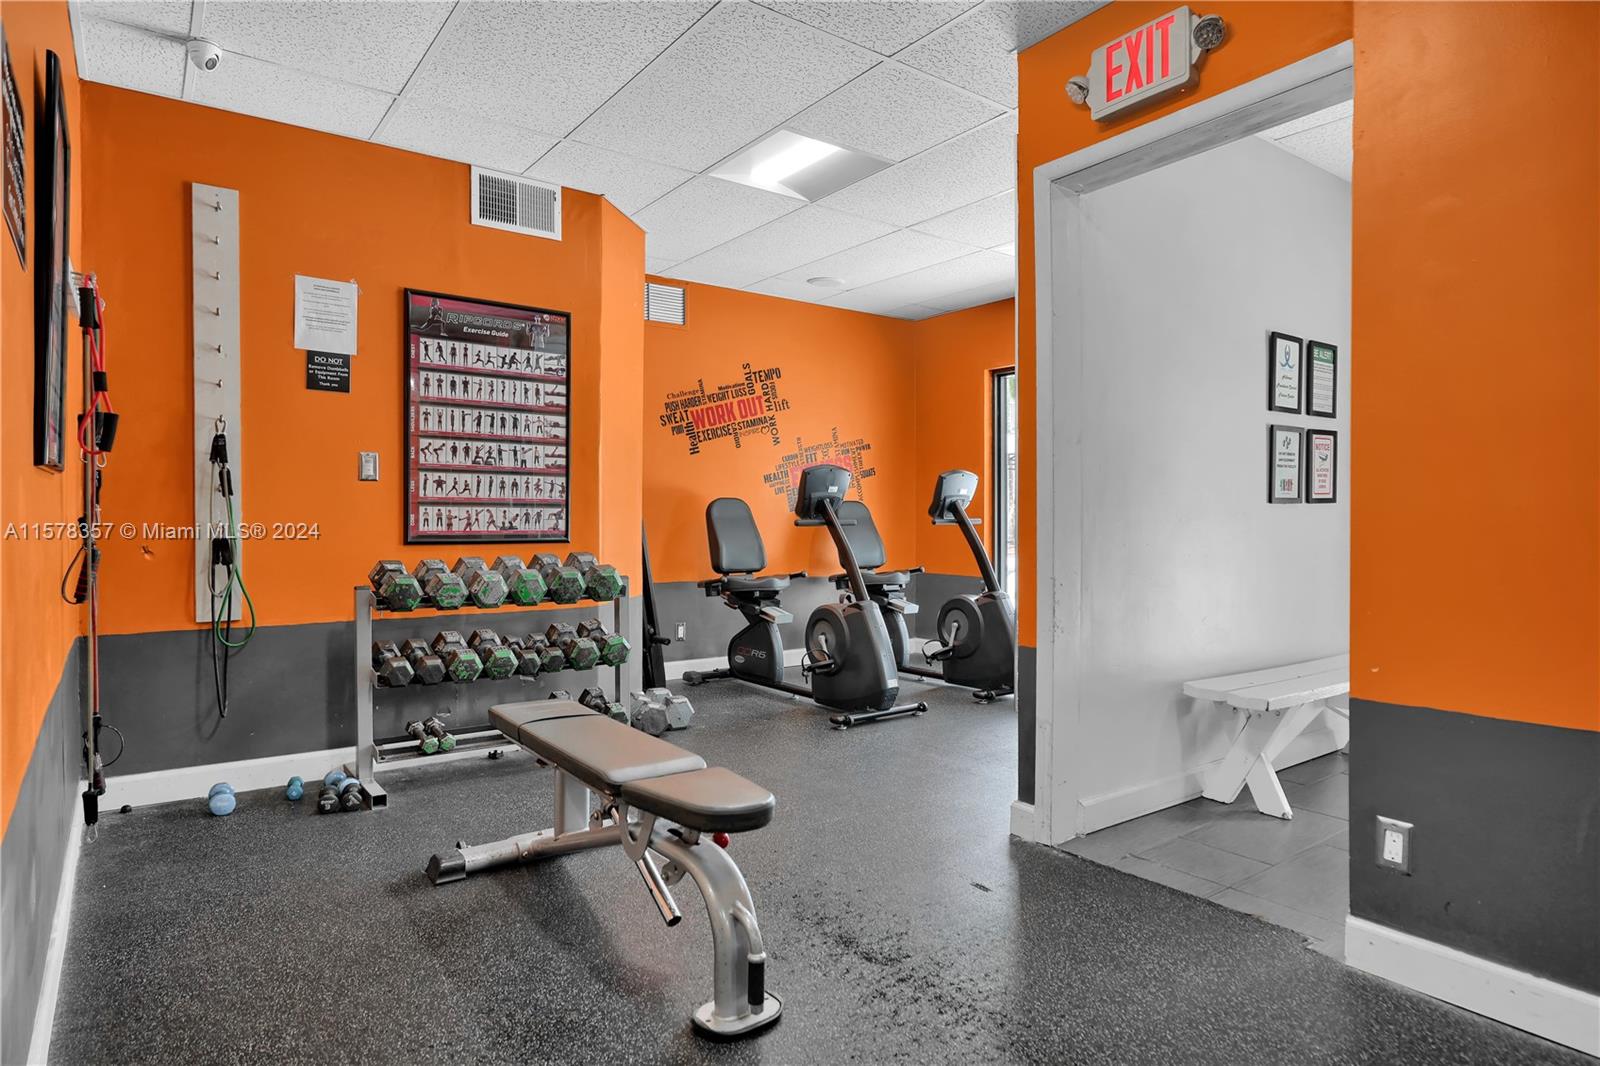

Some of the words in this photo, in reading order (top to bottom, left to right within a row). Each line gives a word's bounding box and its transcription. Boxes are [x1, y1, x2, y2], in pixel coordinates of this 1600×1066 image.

[1106, 15, 1175, 103] EXIT
[446, 312, 522, 331] RIPCORDS
[463, 326, 491, 336] Exercise
[491, 330, 510, 338] Guide
[314, 356, 327, 364] DO
[328, 358, 344, 366] NOT
[742, 362, 755, 396] GOALS
[752, 367, 782, 384] TEMPO
[667, 389, 699, 400] Challenge
[707, 390, 731, 404] WEIGHT
[731, 387, 747, 400] LOSS
[717, 382, 745, 392] Motivation
[664, 399, 681, 413] PUSH
[680, 396, 702, 410] HARDER
[761, 382, 774, 412] HARD
[773, 399, 790, 412] lift
[660, 409, 690, 427] SWEAT
[690, 402, 737, 430] WORK
[737, 395, 766, 419] OUT
[737, 416, 769, 432] STAMINA
[768, 414, 781, 446] WORK
[684, 421, 701, 455] Health
[697, 424, 732, 443] EXERCISE
[775, 460, 801, 471] LIFESTYLE
[805, 452, 817, 464] FIT
[763, 469, 789, 484] HEALTH
